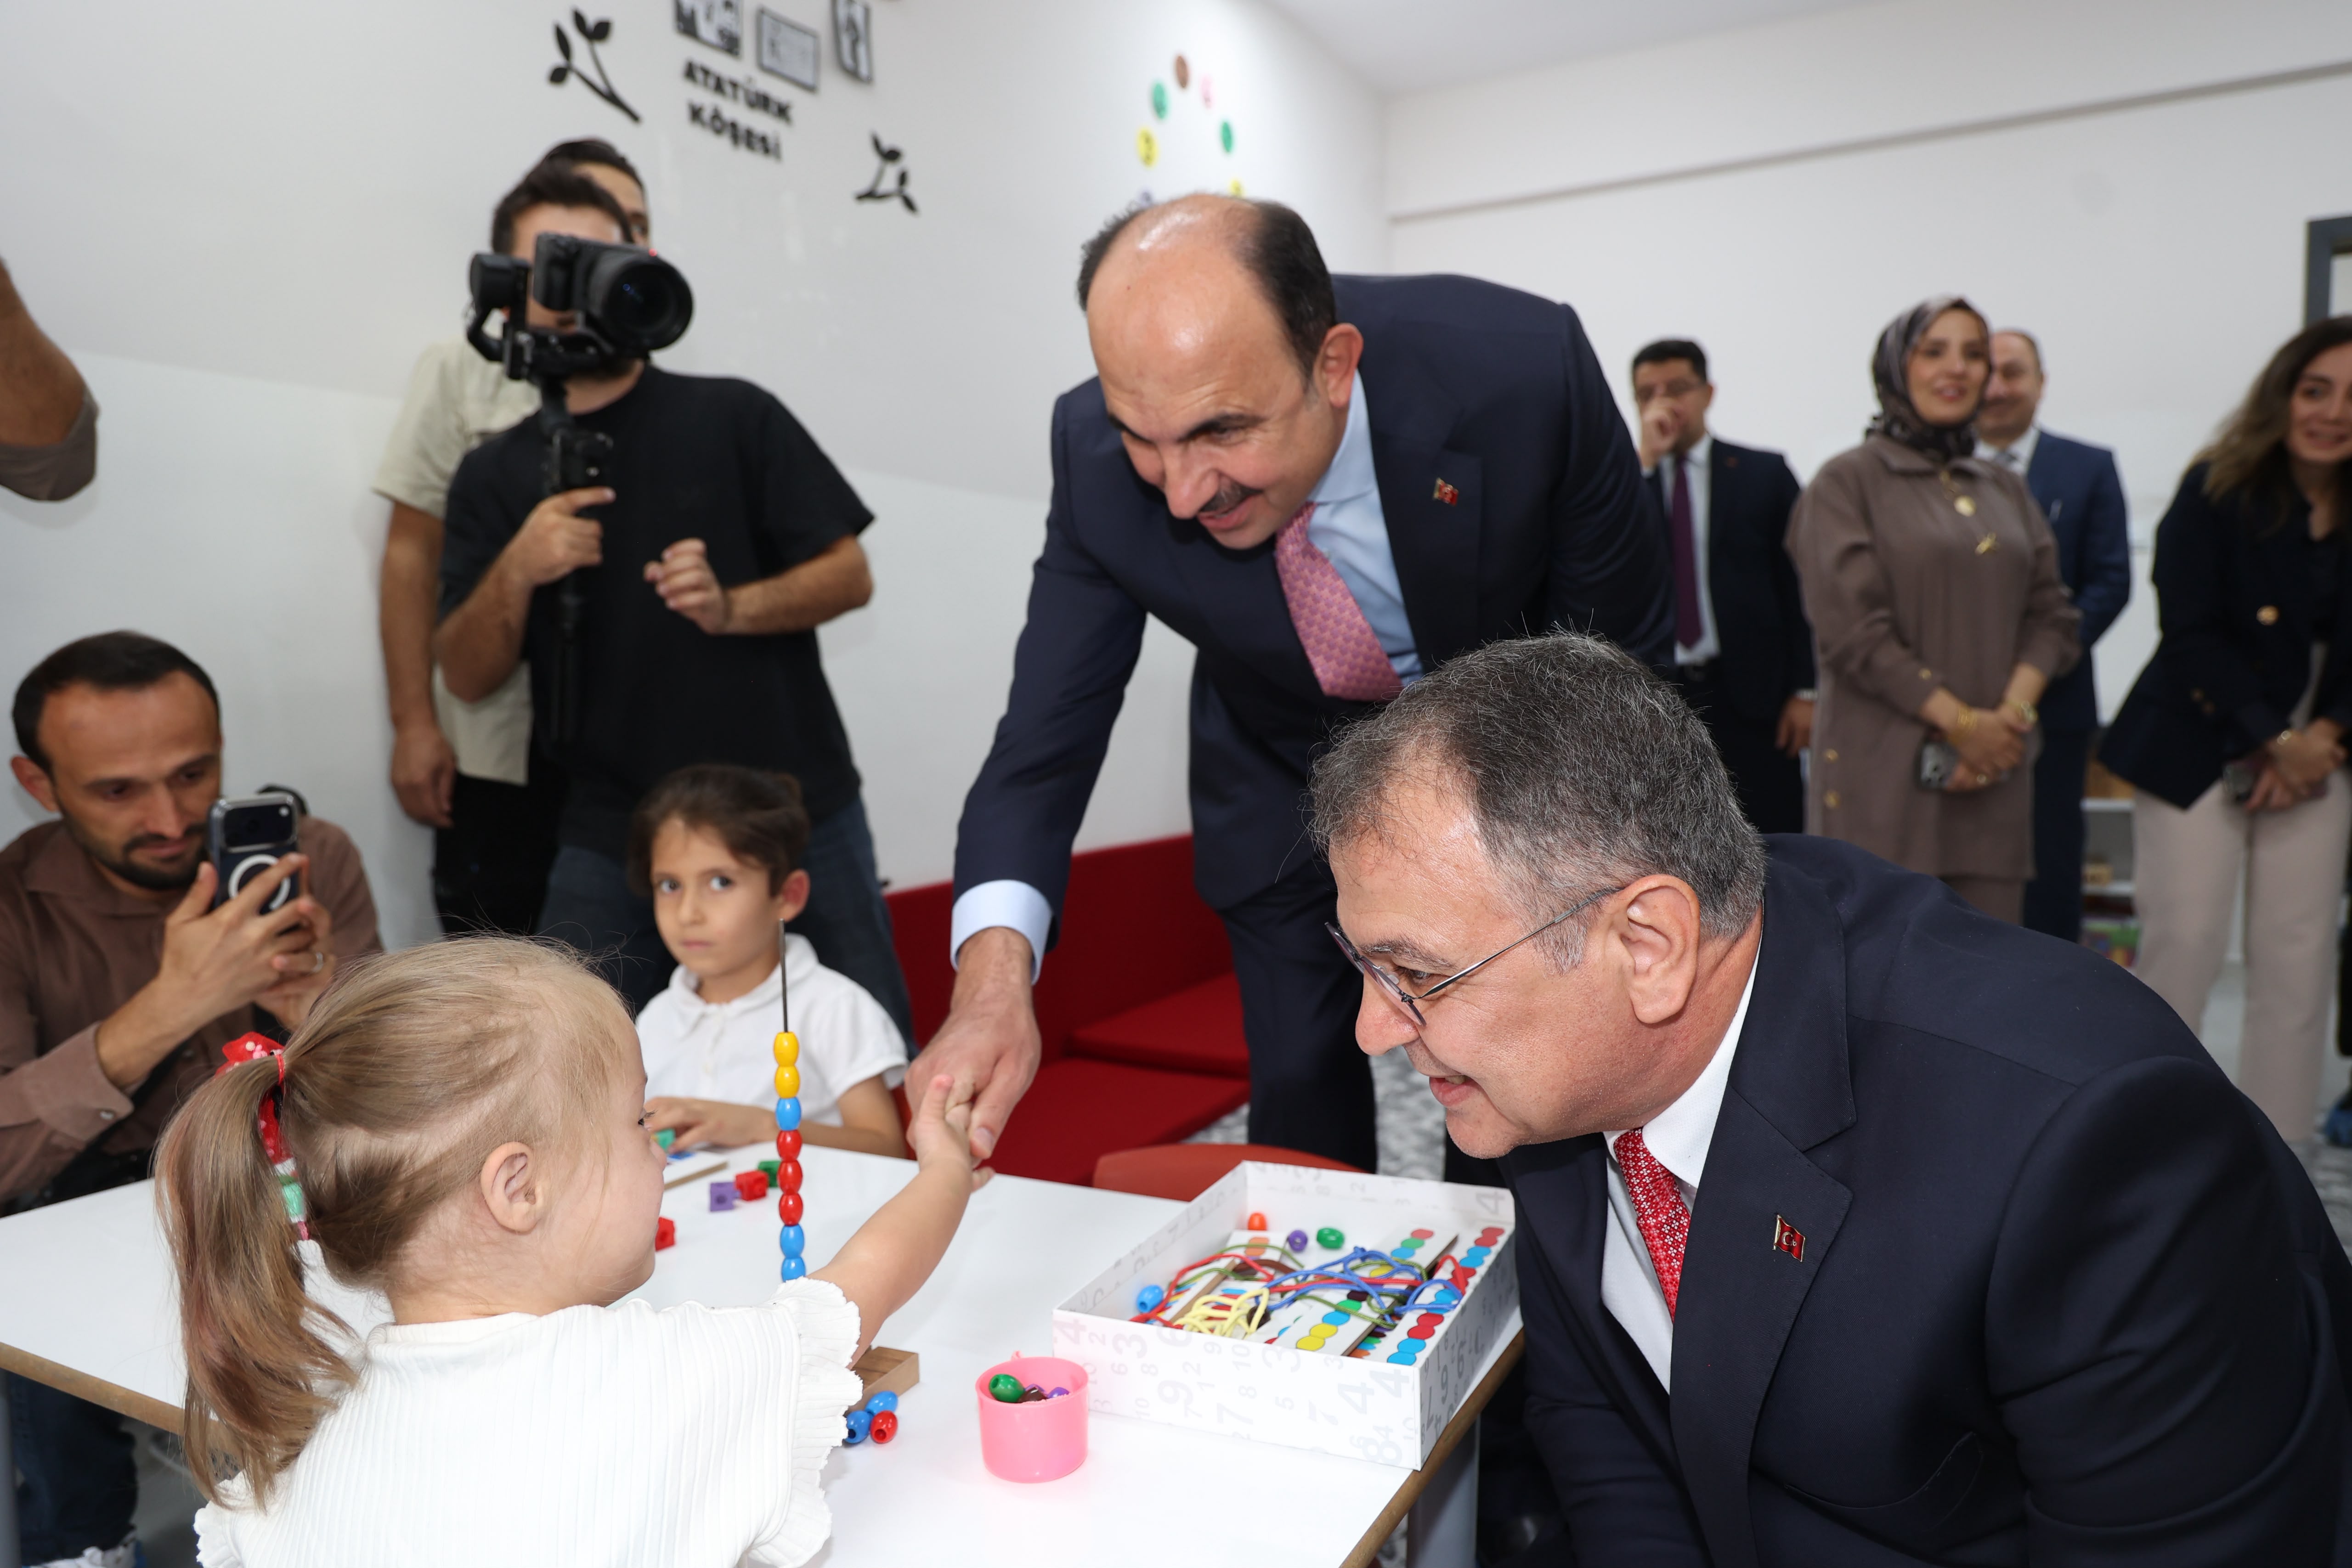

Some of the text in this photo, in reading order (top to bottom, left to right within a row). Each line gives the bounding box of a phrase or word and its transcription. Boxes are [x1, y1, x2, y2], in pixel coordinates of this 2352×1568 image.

[684, 59, 792, 124] ATATÜRK
[688, 102, 781, 160] KÖŞESİ
[1476, 1191, 1505, 1216] 4
[1088, 1332, 1106, 1346] 2
[1112, 1333, 1147, 1359] 3
[1141, 1364, 1158, 1376] 8
[1182, 1361, 1201, 1376] 2
[1232, 1344, 1251, 1371] 10
[1369, 1369, 1409, 1399] 4
[1338, 1382, 1374, 1415] 4
[1217, 1403, 1253, 1425] 7
[1363, 1438, 1402, 1466] 8
